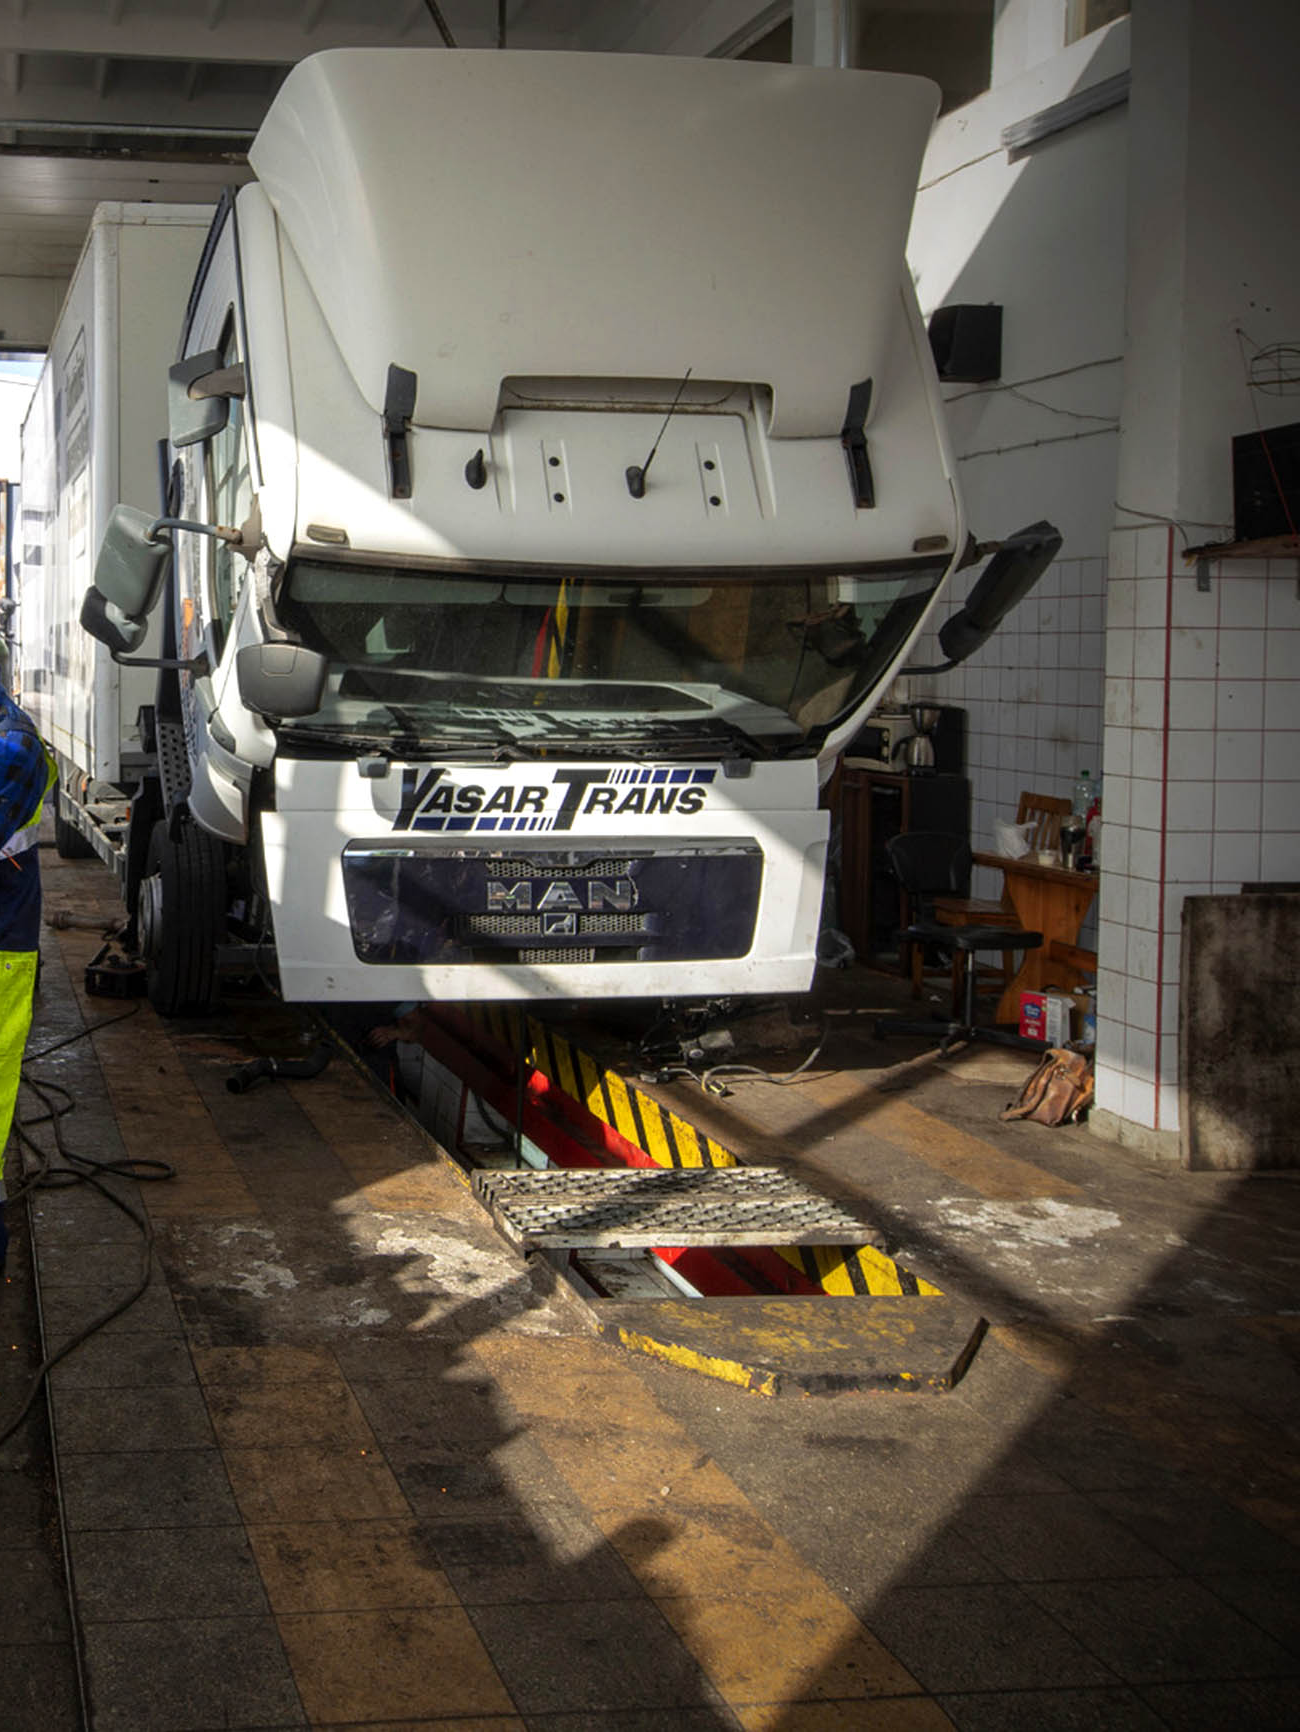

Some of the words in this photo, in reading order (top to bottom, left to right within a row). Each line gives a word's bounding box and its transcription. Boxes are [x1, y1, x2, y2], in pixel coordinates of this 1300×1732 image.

[391, 767, 550, 832] YASAR
[551, 768, 708, 831] TRANS
[486, 880, 634, 911] MAN
